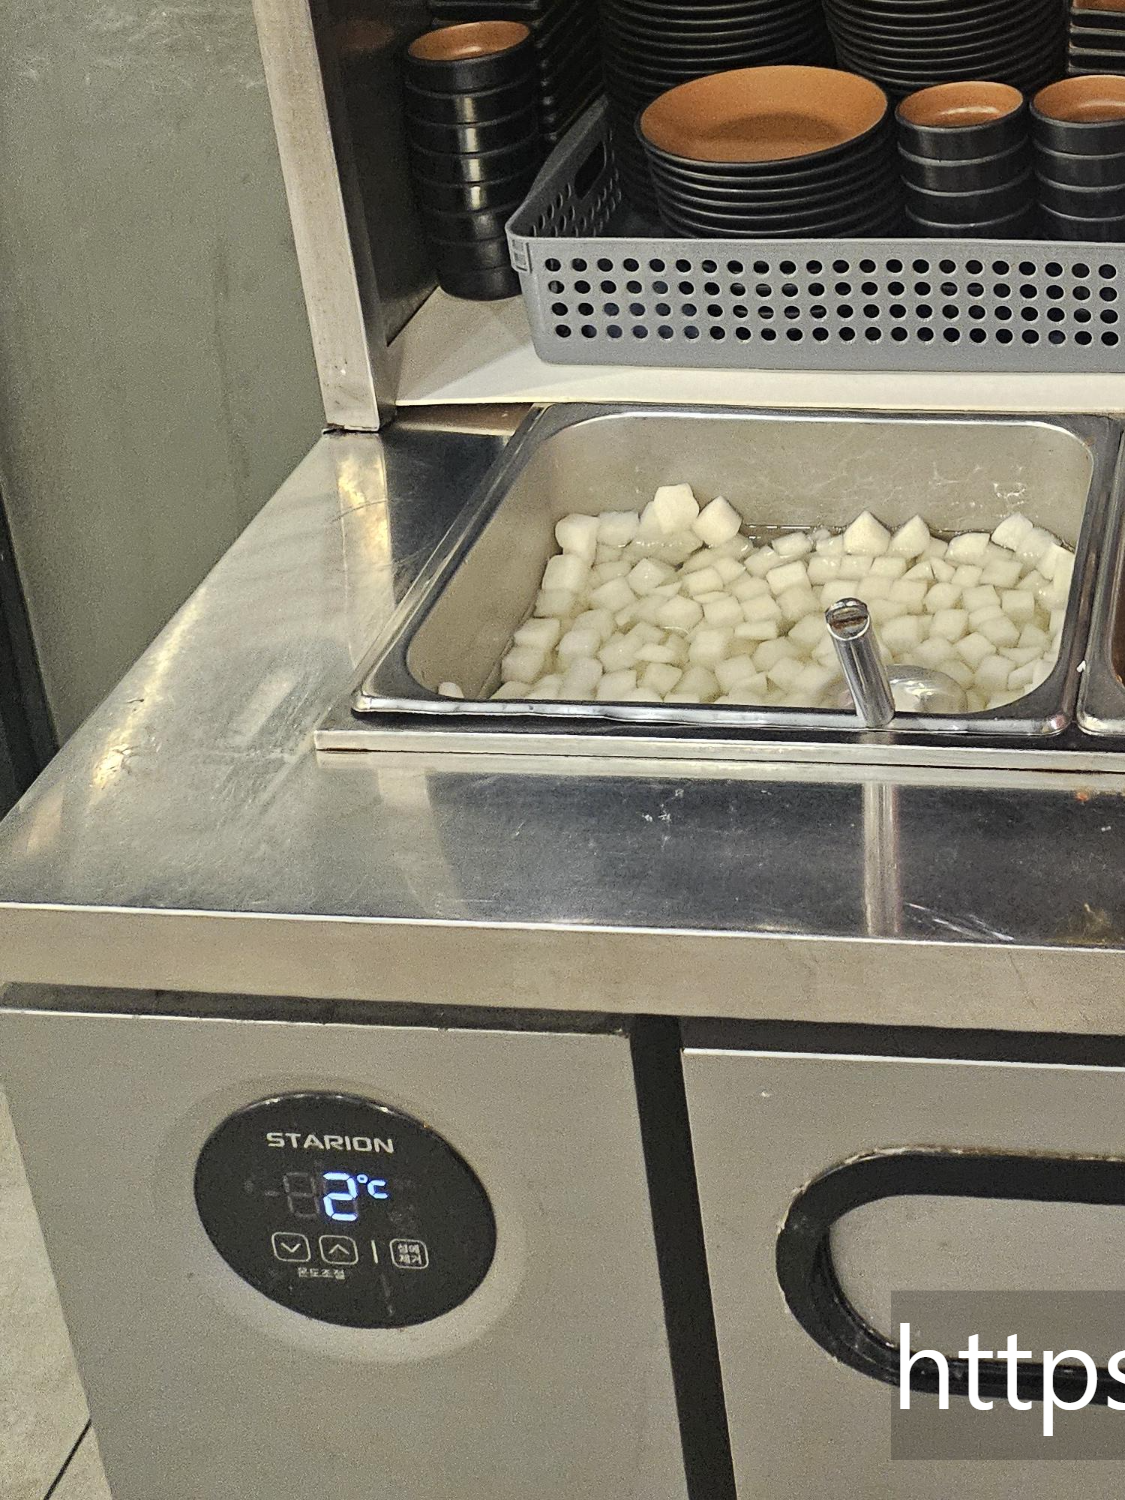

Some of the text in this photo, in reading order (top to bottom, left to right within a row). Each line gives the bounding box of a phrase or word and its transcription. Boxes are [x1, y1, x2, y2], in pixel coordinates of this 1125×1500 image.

[266, 1132, 395, 1154] STARION
[398, 1254, 422, 1265] 제거
[298, 1266, 346, 1281] 온도조절
